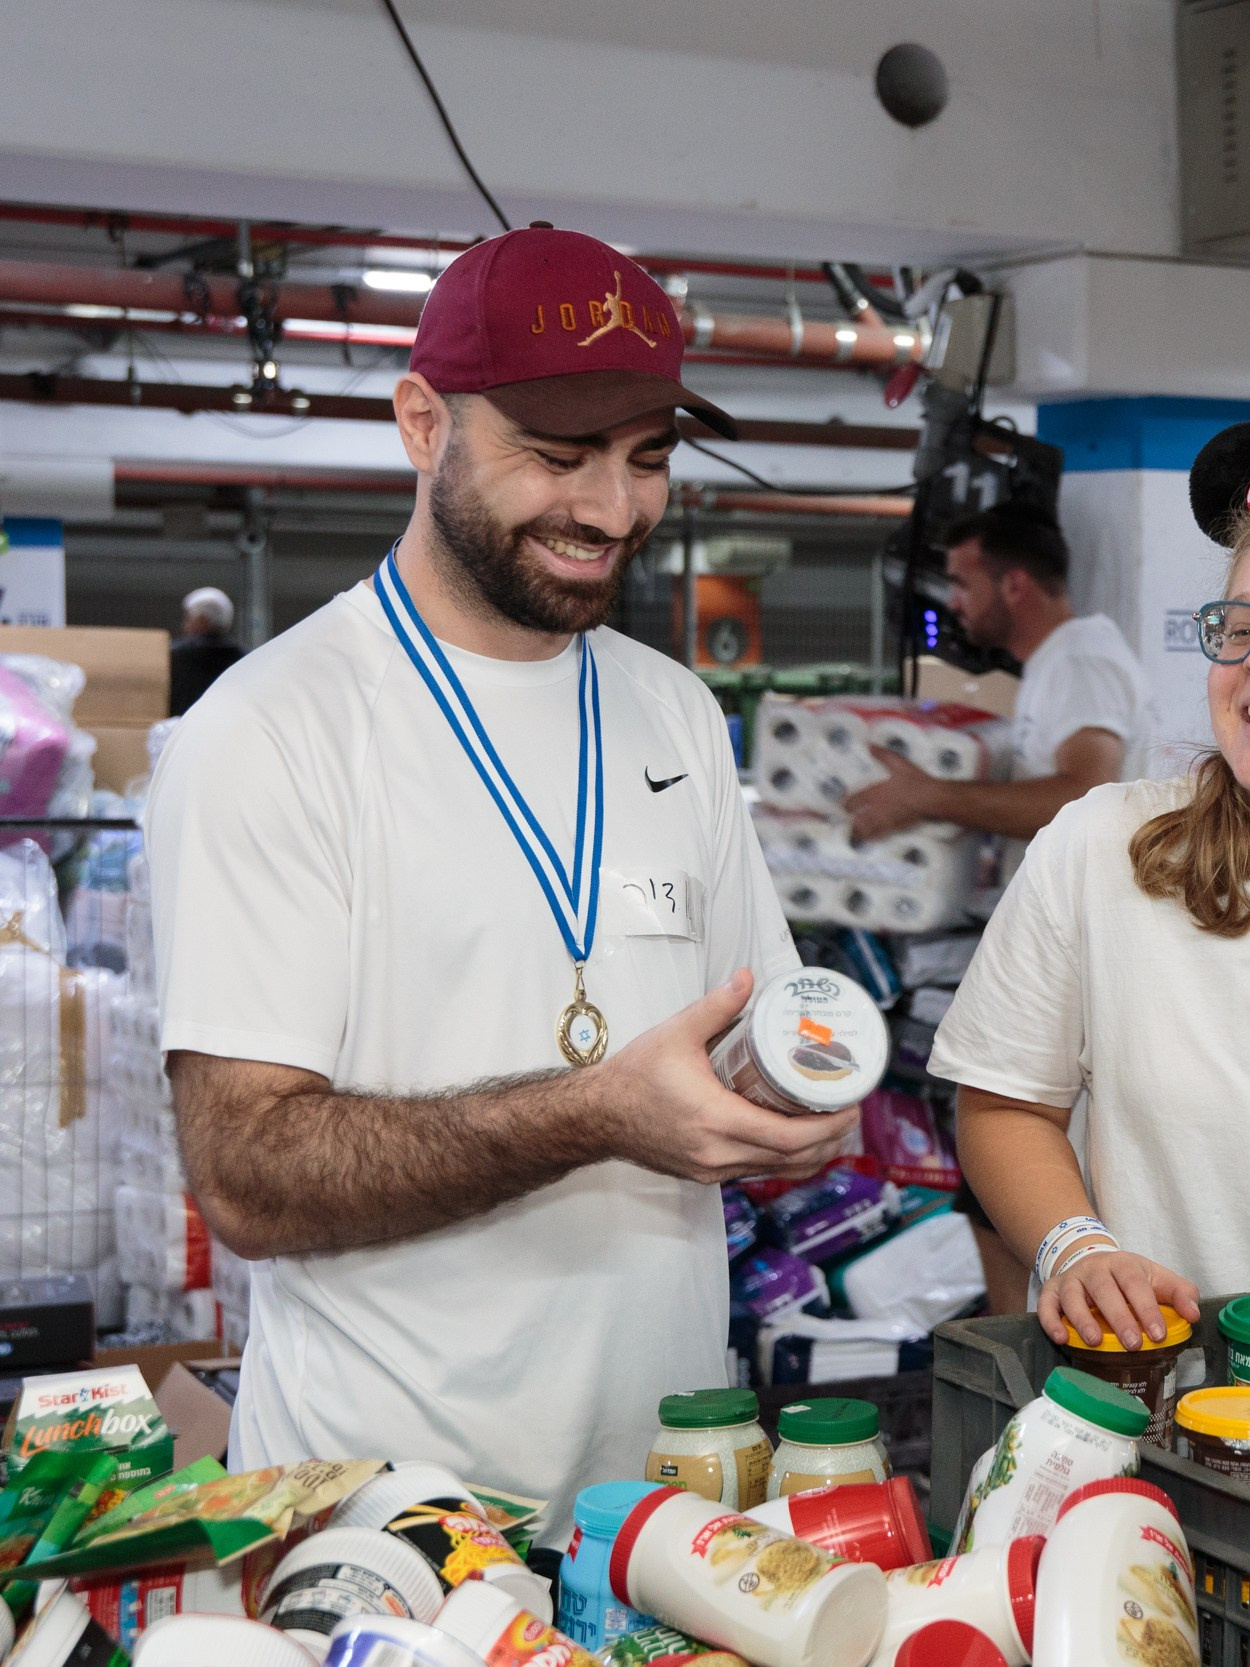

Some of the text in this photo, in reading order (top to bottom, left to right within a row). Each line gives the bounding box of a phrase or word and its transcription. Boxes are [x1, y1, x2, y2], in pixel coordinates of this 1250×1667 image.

[531, 300, 672, 338] JORDAN
[38, 1383, 128, 1408] Star Kist
[20, 1408, 153, 1458] Lunchbox
